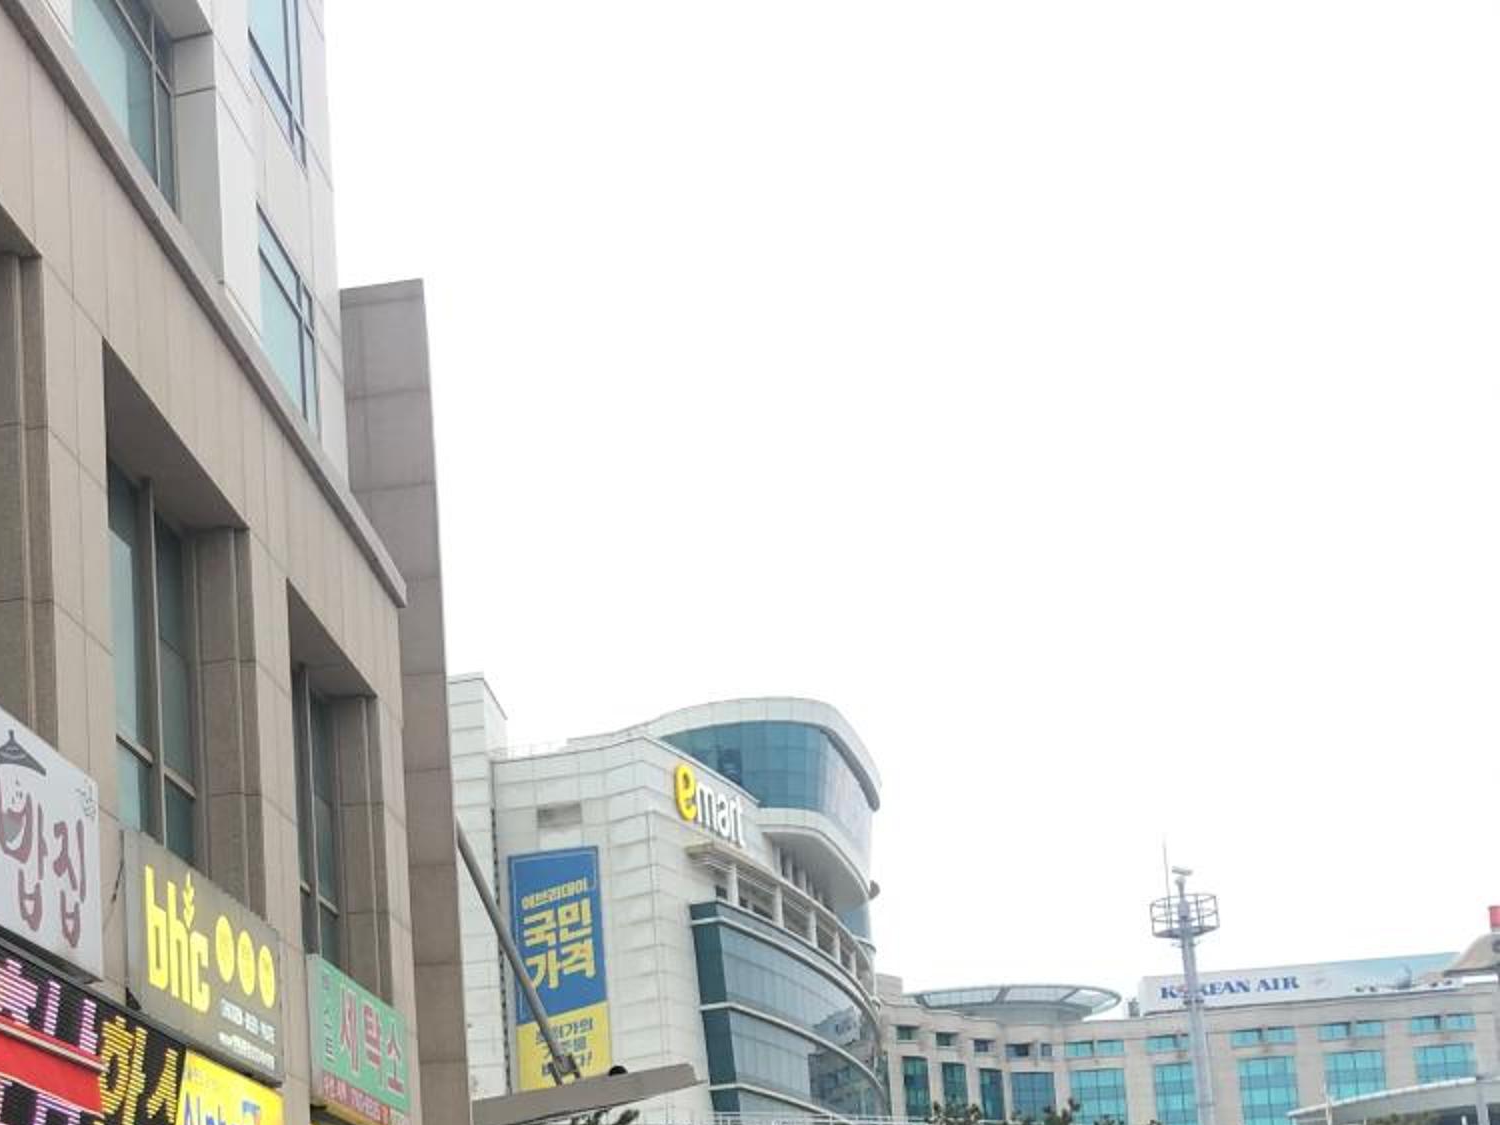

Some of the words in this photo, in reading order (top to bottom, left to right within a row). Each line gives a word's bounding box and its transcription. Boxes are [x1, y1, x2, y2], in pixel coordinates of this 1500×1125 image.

[674, 764, 746, 848] emart
[145, 864, 210, 1014] bhc
[523, 897, 592, 947] 국민
[525, 938, 596, 989] 가격
[1256, 976, 1300, 993] AIR
